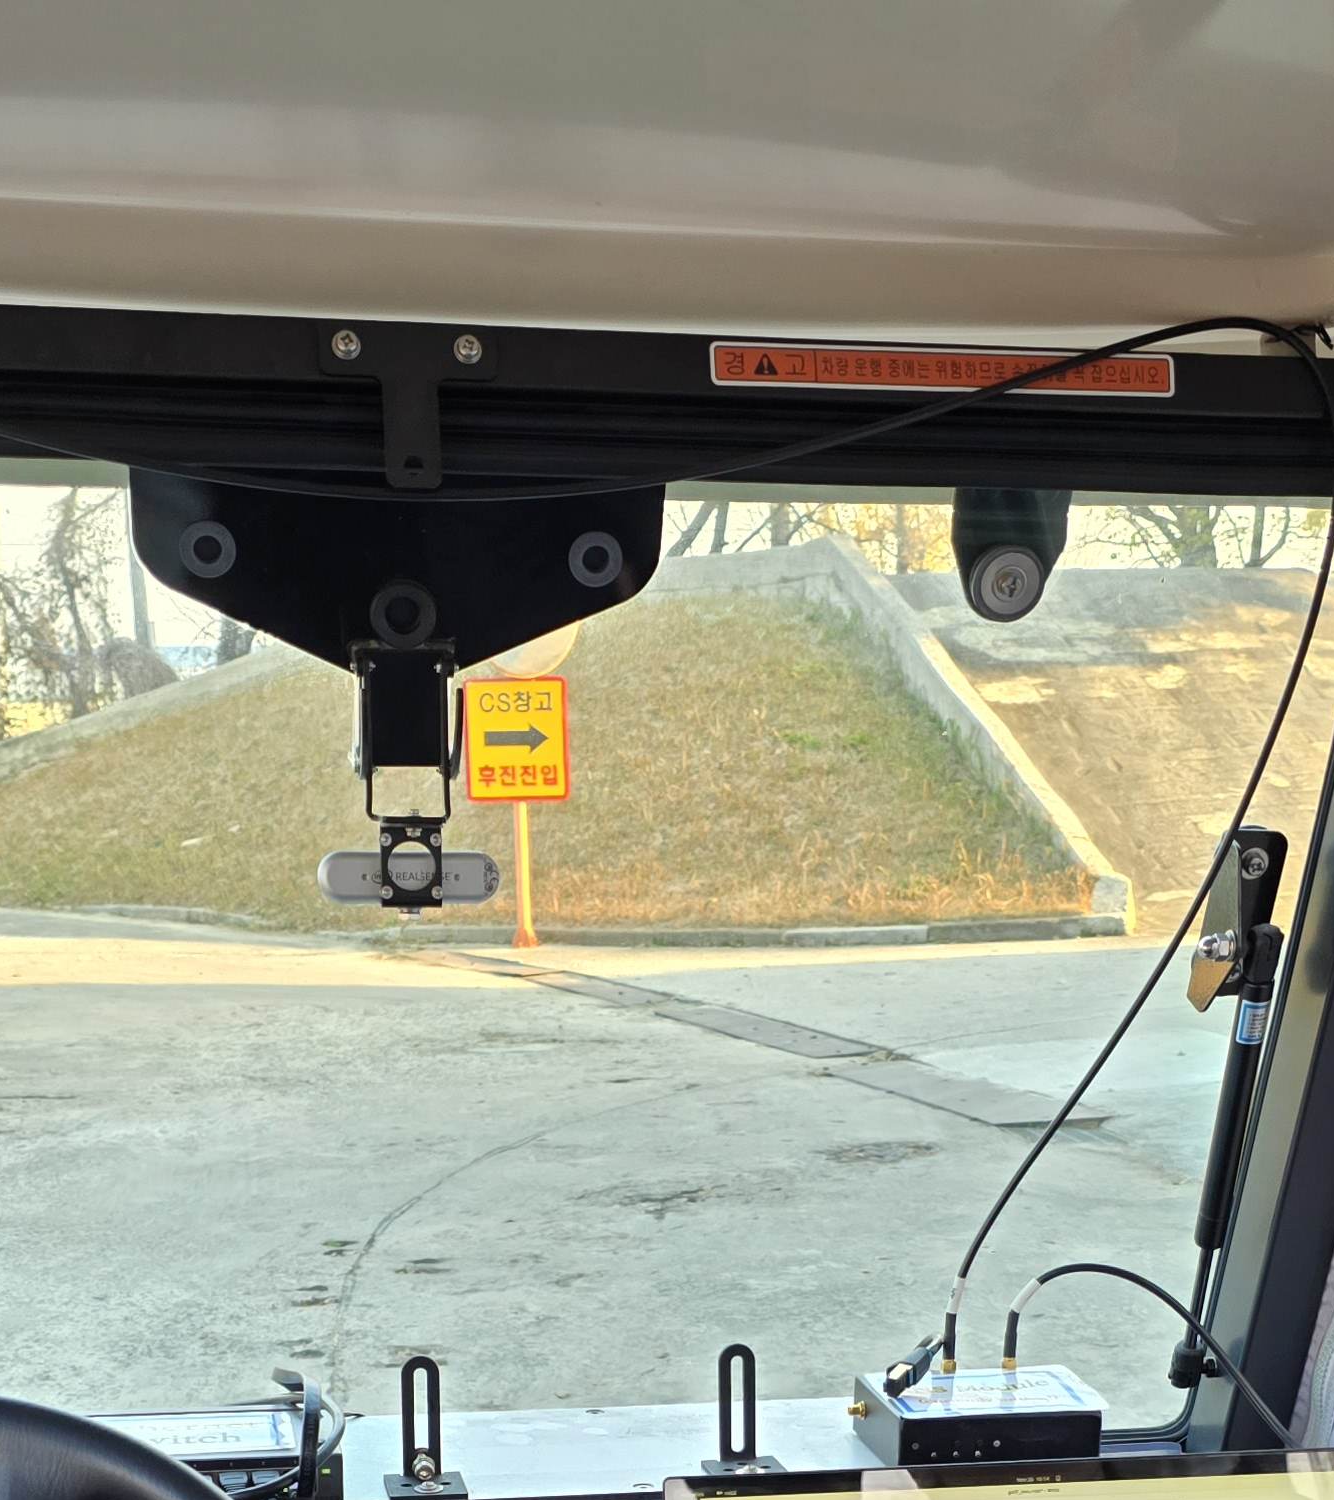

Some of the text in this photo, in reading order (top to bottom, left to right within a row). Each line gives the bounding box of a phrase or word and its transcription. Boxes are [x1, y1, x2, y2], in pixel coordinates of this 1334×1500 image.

[724, 351, 807, 376] 경 고
[821, 357, 849, 377] 차량
[854, 358, 882, 378] 운행
[888, 359, 930, 379] 중에는
[935, 359, 1007, 380] 위험하므로
[1090, 364, 1165, 385] 잡으십시오.
[479, 690, 553, 713] CS창고
[477, 765, 559, 788] 후진진입
